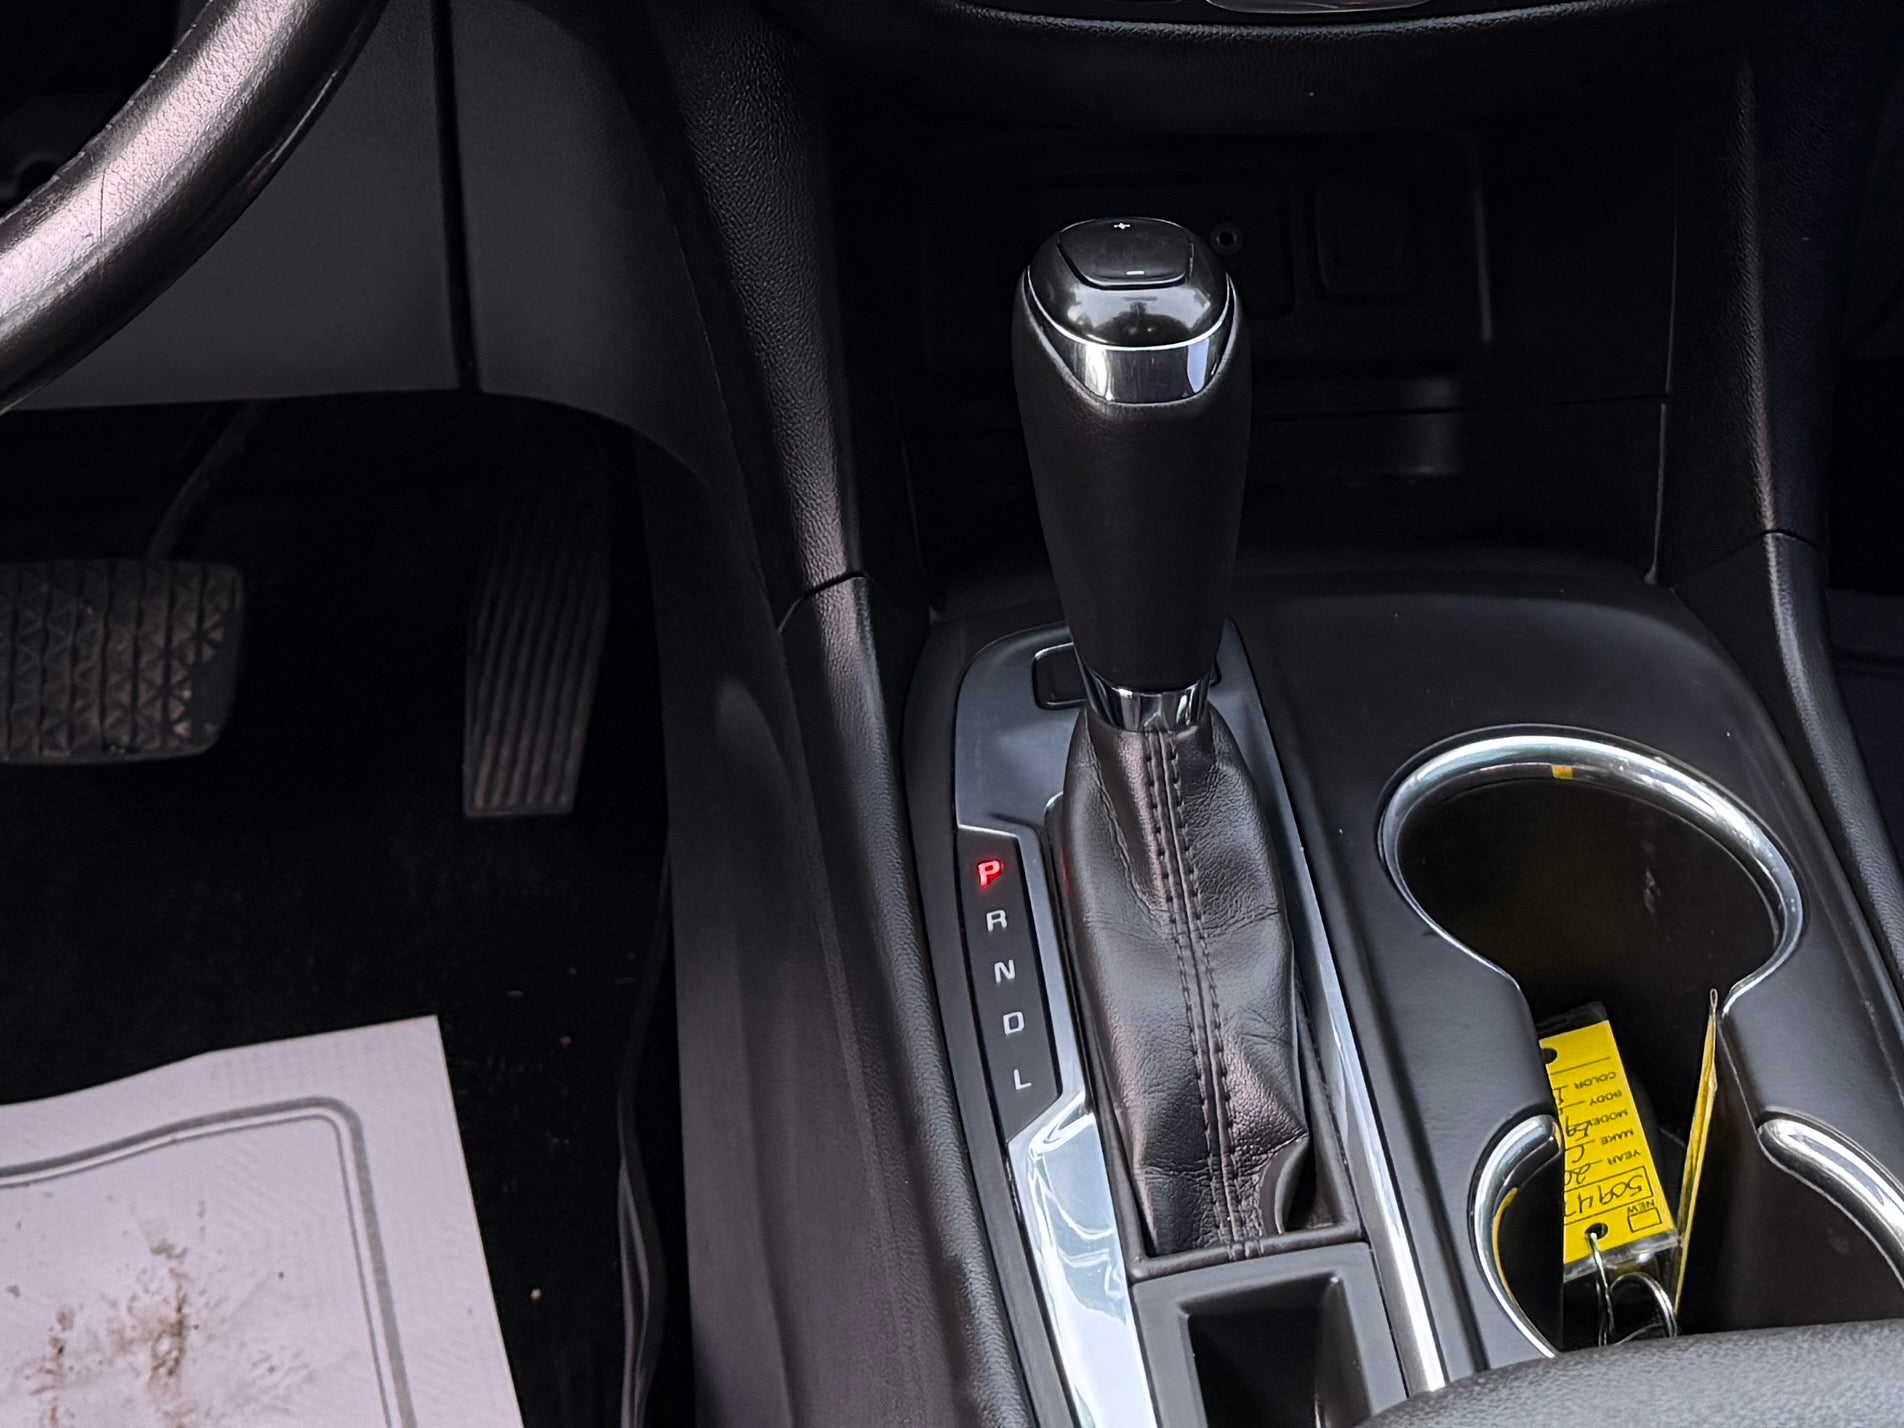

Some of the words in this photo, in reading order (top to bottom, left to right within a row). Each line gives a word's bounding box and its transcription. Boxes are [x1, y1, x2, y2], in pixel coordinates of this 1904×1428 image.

[977, 859, 1002, 887] P
[985, 909, 1008, 933] R
[993, 958, 1017, 984] N
[1002, 1010, 1025, 1037] D
[1012, 1068, 1033, 1091] L
[1573, 1071, 1617, 1090] COLOR
[1589, 1089, 1623, 1107] BODY
[1599, 1128, 1635, 1145] MAKE
[1606, 1148, 1642, 1166] YEAR
[1626, 1198, 1656, 1214] NEW
